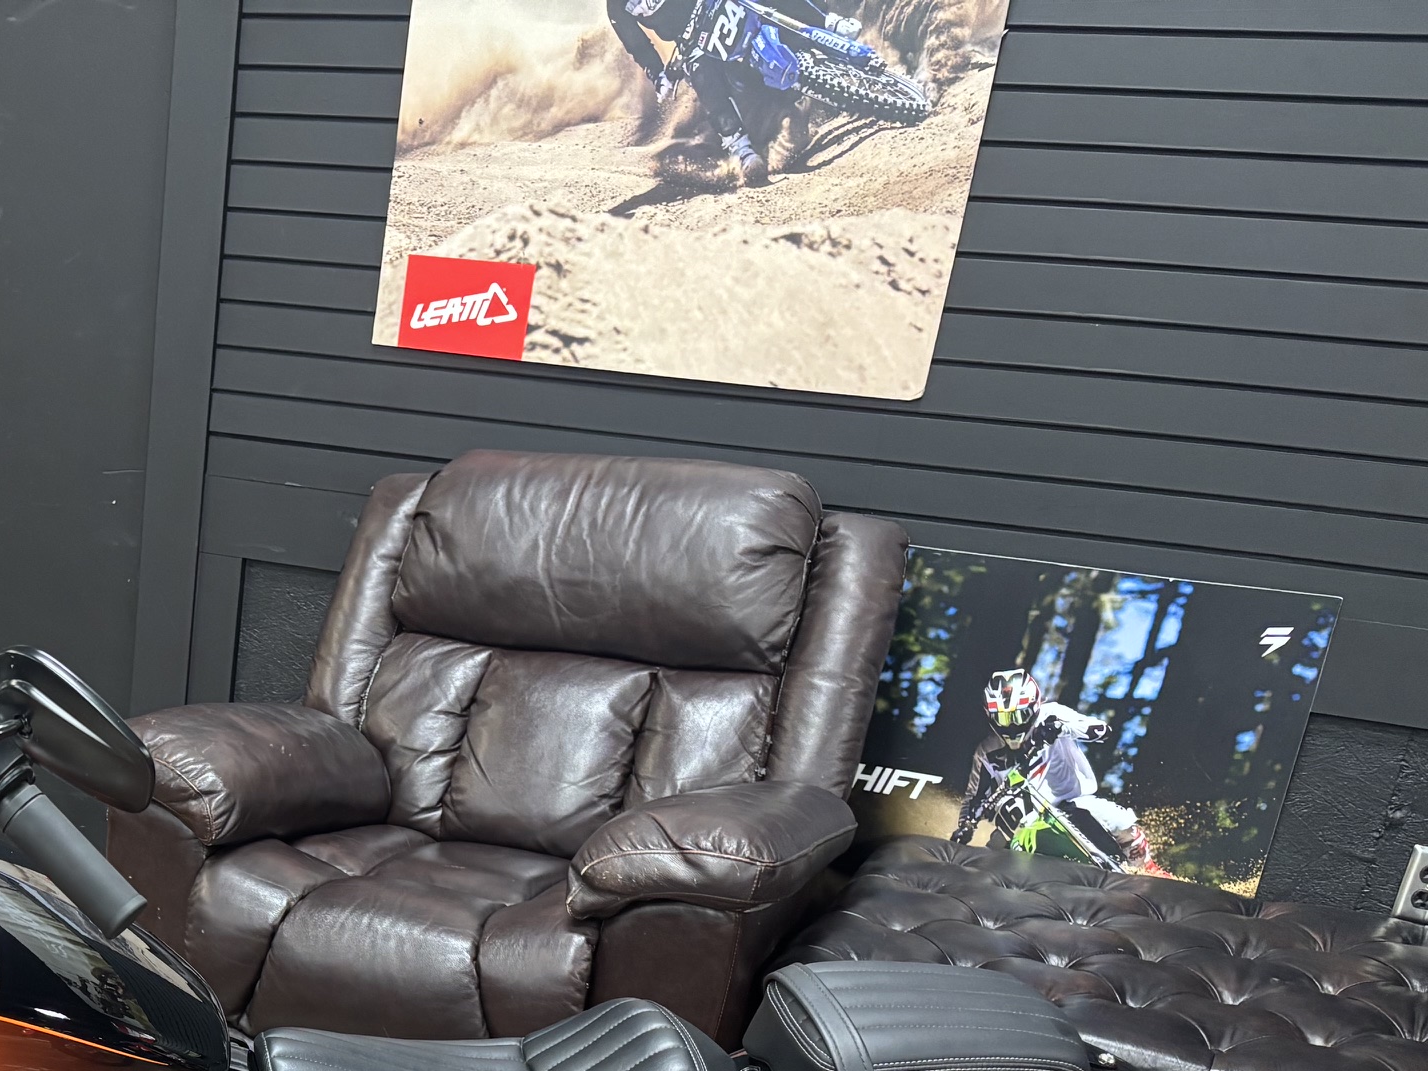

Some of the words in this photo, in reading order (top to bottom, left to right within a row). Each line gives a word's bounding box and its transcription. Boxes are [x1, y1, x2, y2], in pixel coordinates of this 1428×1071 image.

[707, 0, 745, 61] 734
[410, 292, 492, 329] LEATT
[852, 763, 943, 799] HIFT
